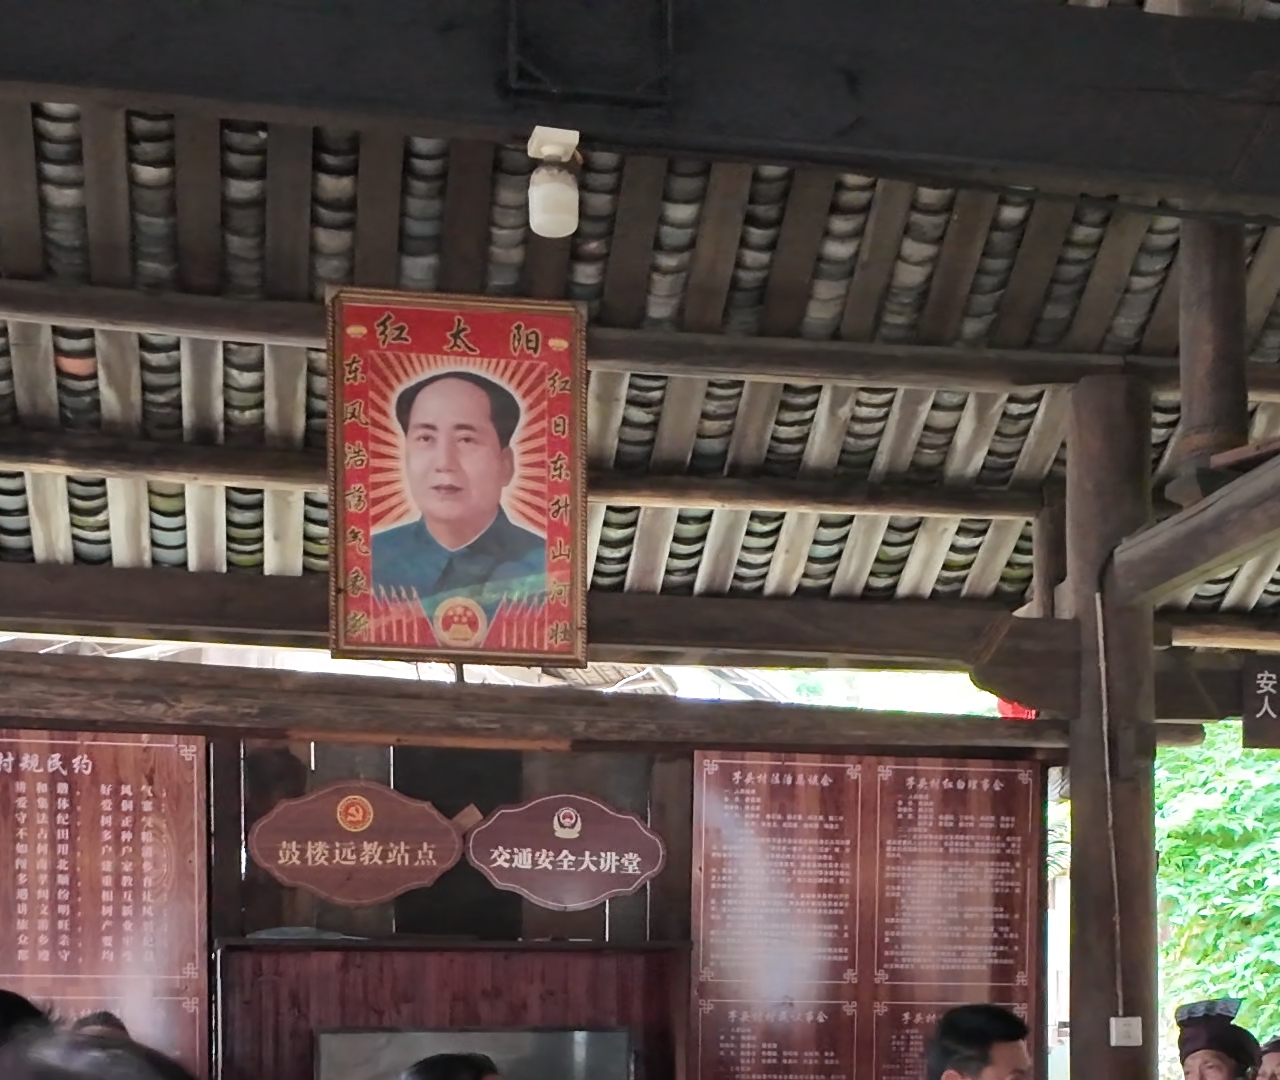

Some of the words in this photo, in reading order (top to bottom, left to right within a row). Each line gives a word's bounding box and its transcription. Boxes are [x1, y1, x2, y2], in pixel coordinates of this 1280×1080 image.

[375, 313, 542, 357] 红太阳
[343, 356, 371, 643] 东风浩荡气象新
[547, 369, 572, 645] 红日东升山河壮
[277, 840, 438, 867] 鼓楼远教站点
[489, 845, 642, 875] 交通安全大讲堂
